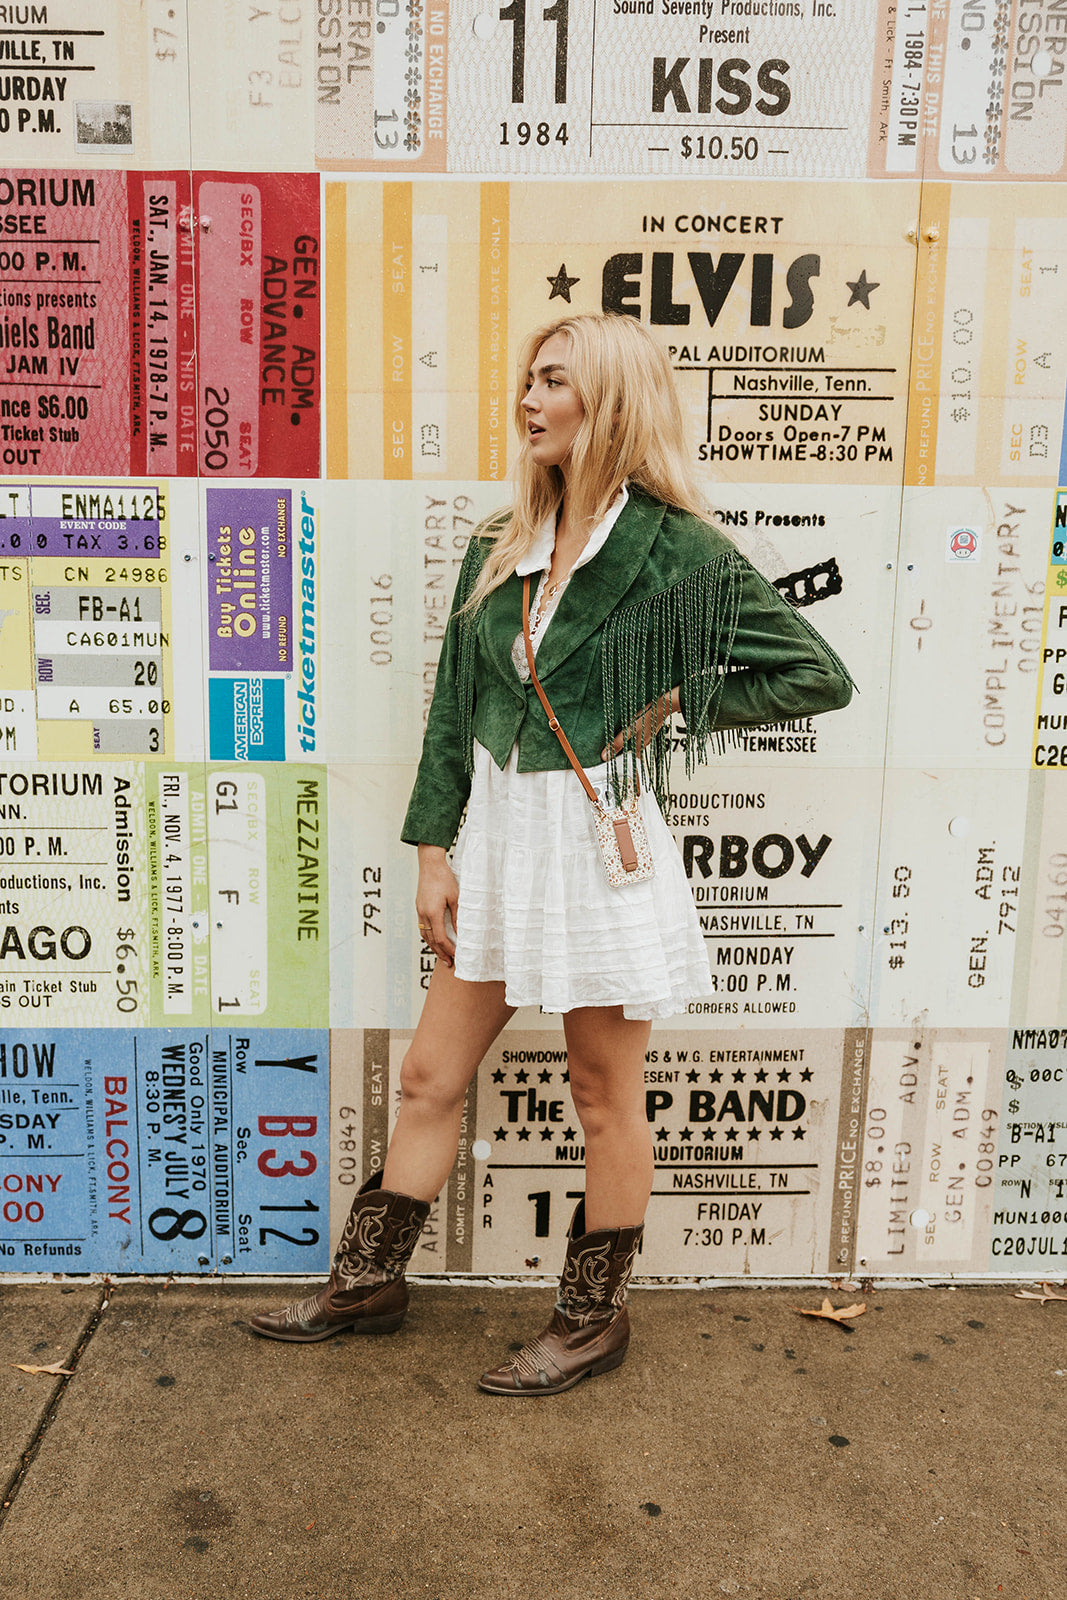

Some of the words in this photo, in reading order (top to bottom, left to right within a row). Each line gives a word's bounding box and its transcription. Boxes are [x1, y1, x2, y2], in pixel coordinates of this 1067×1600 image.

[429, 11, 444, 36] NO
[614, 0, 654, 14] Sound
[662, 0, 714, 19] Seventy
[722, 0, 804, 20] Productions,
[812, 2, 837, 17] Inc.
[53, 41, 74, 60] TN
[500, 0, 568, 104] 11
[700, 25, 750, 43] Present
[428, 44, 444, 140] EXCHANGE
[652, 57, 791, 116] KISS
[922, 92, 940, 137] DATE
[500, 122, 568, 146] 1984
[681, 135, 758, 161] $10.50
[148, 195, 169, 243] SAT.,
[240, 193, 254, 268] SEC/BX
[642, 216, 664, 233] IN
[675, 216, 784, 234] CONCERT
[491, 217, 501, 260] ONLY
[148, 249, 169, 292] JAN.
[392, 242, 404, 293] SEAT
[1020, 246, 1034, 298] SEAT
[37, 292, 97, 311] presents
[132, 267, 141, 318] WILLIAMS
[180, 283, 194, 319] ONE
[490, 267, 500, 306] DATE
[602, 252, 820, 330] ELVIS
[48, 316, 95, 350] Band
[148, 299, 169, 330] 14,
[240, 298, 254, 345] ROW
[262, 255, 288, 406] ADVANCE
[490, 312, 500, 360] ABOVE
[708, 346, 825, 363] AUDITORIUM
[6, 355, 48, 374] JAM
[60, 357, 80, 376] IV
[392, 334, 404, 382] ROW
[916, 335, 934, 392] PRICE
[1014, 338, 1028, 386] ROW
[490, 372, 500, 392] ON
[734, 375, 818, 394] Nashville,
[825, 376, 872, 392] Tenn.
[38, 395, 88, 420] $6.00
[490, 396, 500, 430] ONE
[759, 404, 842, 422] SUNDAY
[1, 425, 44, 442] Ticket
[50, 427, 80, 442] Stub
[180, 405, 194, 454] DATE
[205, 386, 230, 471] 2050
[392, 419, 404, 458] SEC
[719, 426, 774, 442] Doors
[784, 426, 850, 445] Open-7
[857, 426, 886, 442] PM
[919, 397, 932, 456] REFUND
[1010, 424, 1023, 461] SEC
[3, 449, 41, 465] OUT
[238, 421, 252, 471] SEAT
[490, 436, 500, 480] ADMIT
[698, 444, 858, 462] SHOWTIME-8:30
[864, 446, 893, 462] PM
[918, 465, 928, 486] NO
[60, 520, 95, 530] EVENT
[98, 521, 127, 532] CODE
[62, 493, 166, 522] ENMA1125
[278, 498, 287, 542] EXCHANGE
[755, 511, 826, 527] Presents
[64, 534, 102, 550] TAX
[117, 535, 168, 551] 3.68
[216, 525, 232, 596] Tickets
[278, 544, 286, 558] NO
[65, 567, 90, 582] CN
[105, 568, 168, 584] 24986
[233, 526, 257, 639] Online
[262, 526, 270, 640] www.ticketmaster.com
[35, 590, 51, 615] SEC.
[78, 596, 143, 622] FB-A1
[216, 602, 236, 638] Buy
[66, 632, 170, 648] CA601MUN
[279, 615, 288, 646] REFUND
[297, 497, 317, 753] ticketmaster
[38, 658, 54, 682] ROW
[279, 648, 288, 662] NO
[134, 662, 158, 686] 20
[69, 700, 80, 714] A
[109, 699, 172, 714] 65.00
[234, 682, 248, 760] AMERICAN
[251, 679, 263, 745] EXPRESS
[149, 728, 160, 752] 3
[215, 781, 238, 816] G1
[248, 781, 258, 841] SEC/BX
[164, 814, 181, 849] NOV.
[190, 791, 204, 848] ADMIT
[114, 776, 134, 902] Admission
[150, 840, 158, 883] WILLIAMS
[192, 856, 206, 886] ONE
[296, 780, 320, 942] MEZZANINE
[80, 874, 106, 890] Inc.
[218, 890, 240, 905] F
[248, 868, 260, 905] ROW
[998, 866, 1021, 935] 7912
[363, 867, 382, 936] 7912
[888, 866, 912, 970] $13.50
[700, 915, 787, 932] NASHVILLE,
[796, 915, 814, 930] TN
[0, 926, 92, 960] AGO
[717, 947, 795, 966] MONDAY
[24, 980, 62, 994] Ticket
[70, 980, 98, 994] Stub
[115, 927, 138, 1014] $6.50
[194, 956, 208, 996] DATE
[249, 969, 260, 1008] SEAT
[757, 974, 798, 992] P.M.
[19, 995, 52, 1008] OUT
[188, 1042, 204, 1086] Good
[236, 1037, 250, 1074] Row
[254, 1054, 318, 1074] Y
[677, 1051, 704, 1064] W.G.
[709, 1049, 805, 1062] ENTERTAINMENT
[146, 1070, 160, 1114] 8:30
[212, 1050, 229, 1136] MUNICIPAL
[372, 1062, 382, 1107] SEAT
[852, 1039, 864, 1114] EXCHANGE
[936, 1066, 950, 1110] SEAT
[32, 1089, 72, 1104] Tenn.
[500, 1088, 564, 1122] The
[689, 1089, 807, 1122] BAND
[190, 1096, 205, 1135] Only
[850, 1119, 858, 1140] NO
[104, 1075, 132, 1226] BALCONY
[236, 1126, 251, 1164] Sec.
[257, 1115, 318, 1178] B3
[338, 1106, 356, 1186] 00849
[458, 1138, 468, 1170] THIS
[930, 1142, 942, 1182] ROW
[998, 1154, 1021, 1168] PP
[164, 1150, 190, 1200] JULY
[191, 1144, 207, 1192] 1970
[672, 1174, 761, 1190] NASHVILLE,
[769, 1174, 788, 1188] TN
[839, 1141, 857, 1190] PRICE
[214, 1144, 230, 1236] AUDITORIUM
[457, 1172, 466, 1200] ONE
[148, 1206, 208, 1241] 8
[259, 1199, 320, 1246] 12
[456, 1204, 465, 1245] ADMIT
[698, 1202, 763, 1221] FRIDAY
[840, 1192, 852, 1244] REFUND
[24, 1244, 82, 1256] Refunds
[238, 1214, 252, 1254] Seat
[683, 1229, 724, 1246] 7:30
[732, 1229, 773, 1246] P.M.
